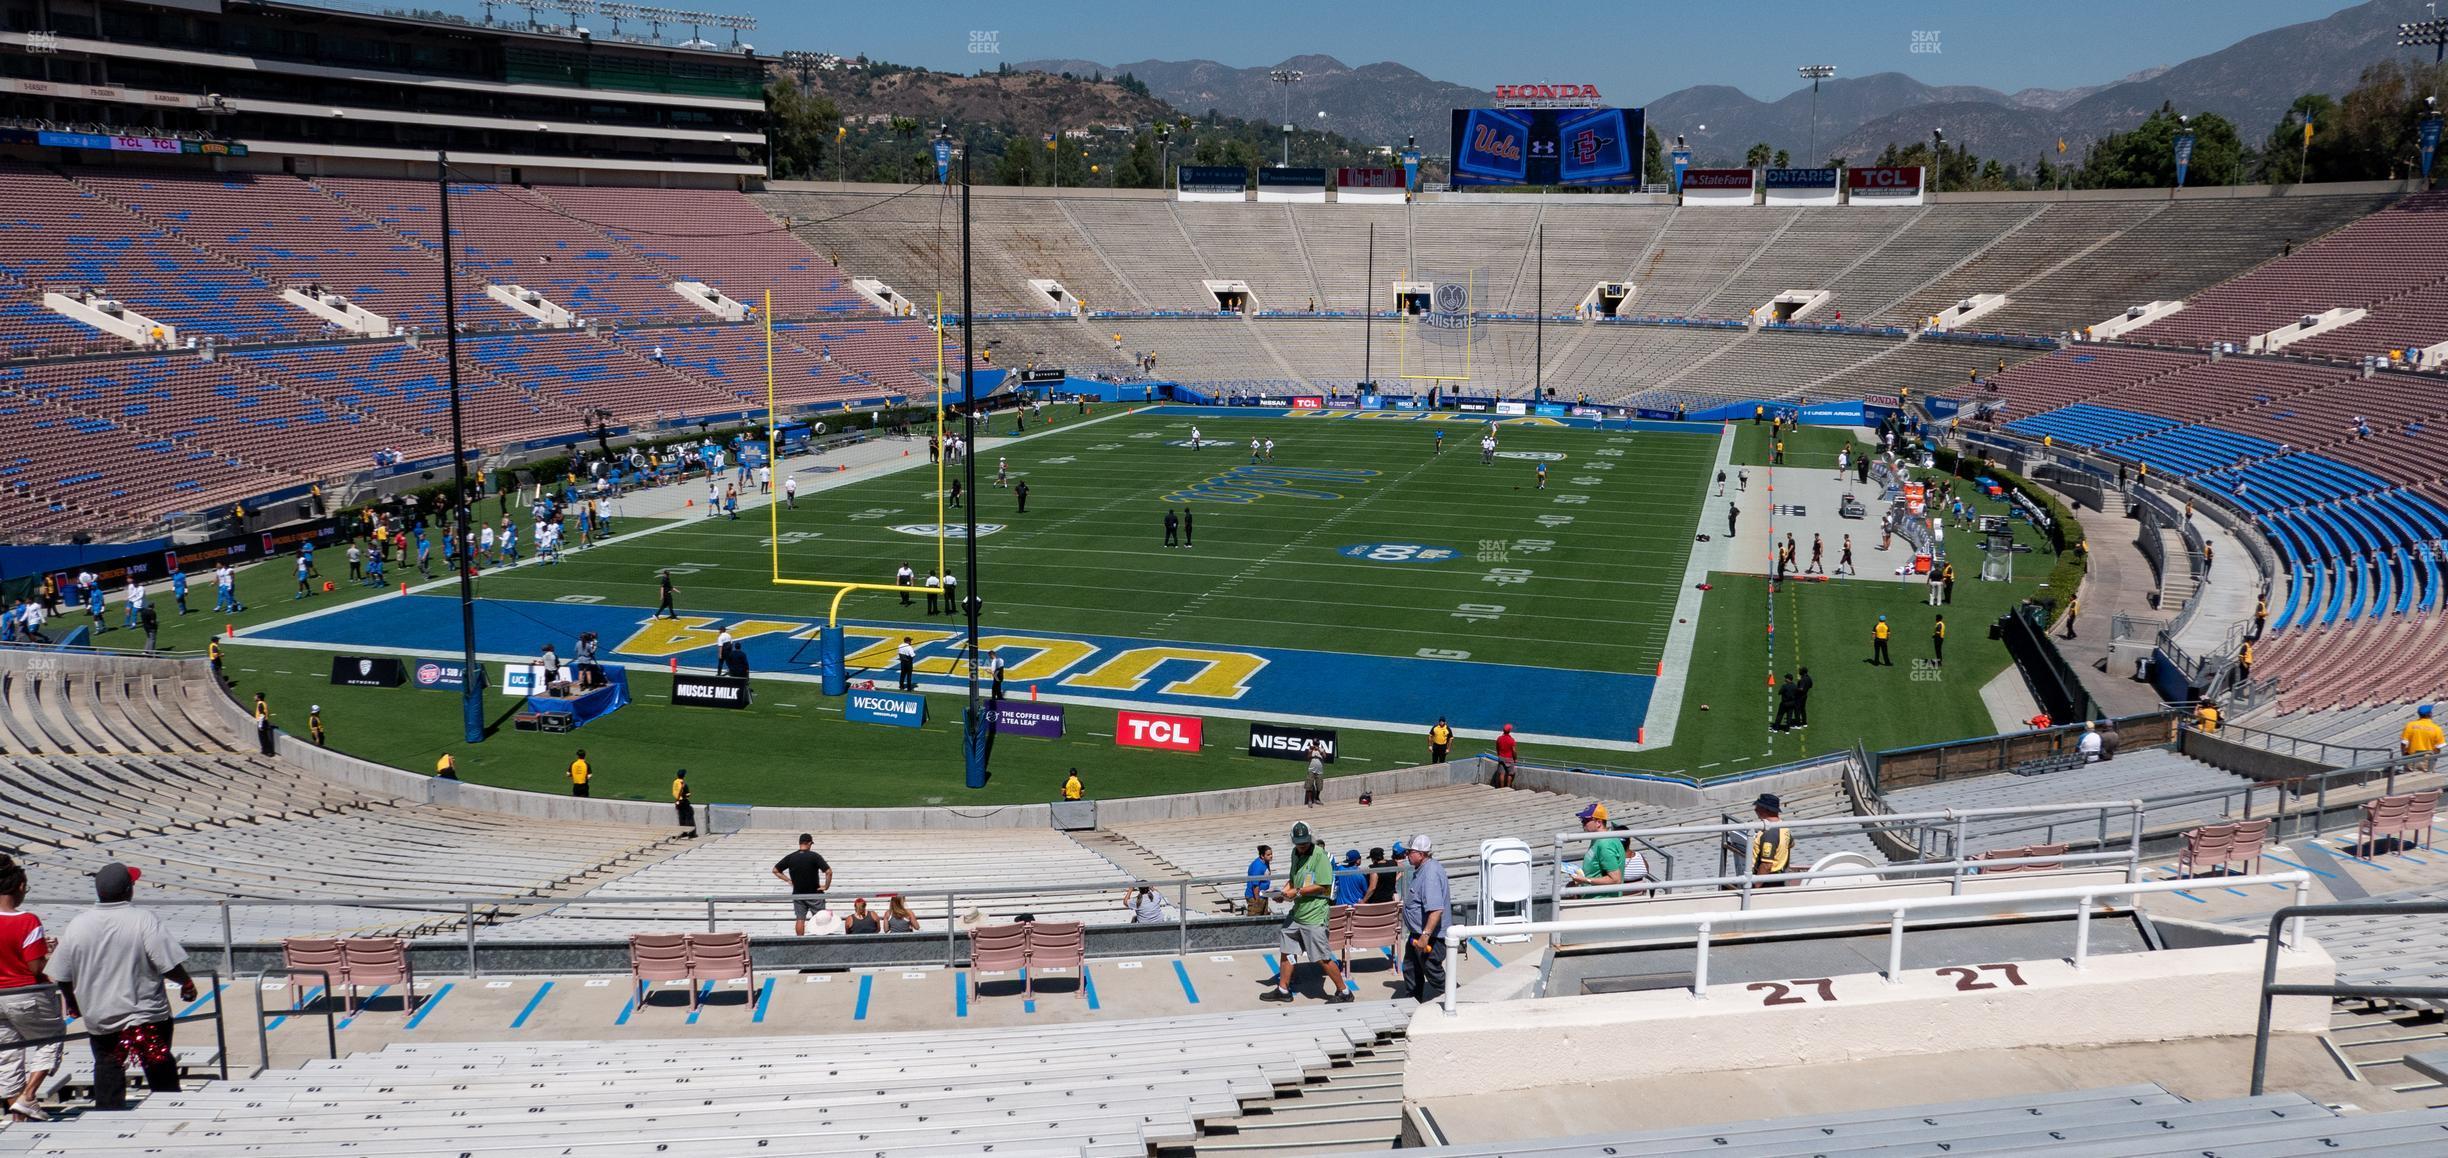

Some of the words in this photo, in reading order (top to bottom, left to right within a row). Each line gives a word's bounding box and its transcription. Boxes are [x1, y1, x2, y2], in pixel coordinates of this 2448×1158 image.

[1495, 85, 1602, 99] HONDA
[118, 137, 143, 148] TCL
[152, 139, 177, 150] TCL
[1767, 170, 1836, 183] ONTARIO
[1860, 169, 1908, 185] TCL
[1426, 313, 1477, 329] Allstate
[1864, 395, 1898, 406] HONDA
[1449, 603, 1506, 620] 10
[2109, 645, 2116, 653] 2
[677, 684, 714, 698] MUSCLE
[714, 685, 740, 700] MILK
[853, 696, 905, 713] WESCOM
[872, 711, 898, 719] wescom.org
[1015, 712, 1039, 720] COFFEE
[1040, 713, 1060, 722] BEAN
[1128, 719, 1190, 744] TCL
[1251, 734, 1333, 754] NISSAN
[1935, 963, 2028, 991] 27
[1746, 978, 1838, 1006] 27
[2130, 1098, 2143, 1106] 1
[2026, 1108, 2043, 1116] 2
[2270, 1109, 2286, 1119] 1
[1923, 1118, 1939, 1126] 3
[2155, 1120, 2176, 1130] 2
[858, 1133, 870, 1141] 4
[1820, 1128, 1836, 1137] 4
[2047, 1132, 2067, 1141] 3
[757, 1139, 769, 1148] 5
[1713, 1137, 1729, 1147] 5
[2317, 1137, 2340, 1148] 2
[561, 1147, 574, 1156] 7
[656, 1144, 669, 1152] 6
[983, 1145, 994, 1153] 2
[1603, 1146, 1618, 1157] 6
[1936, 1143, 1953, 1153] 4
